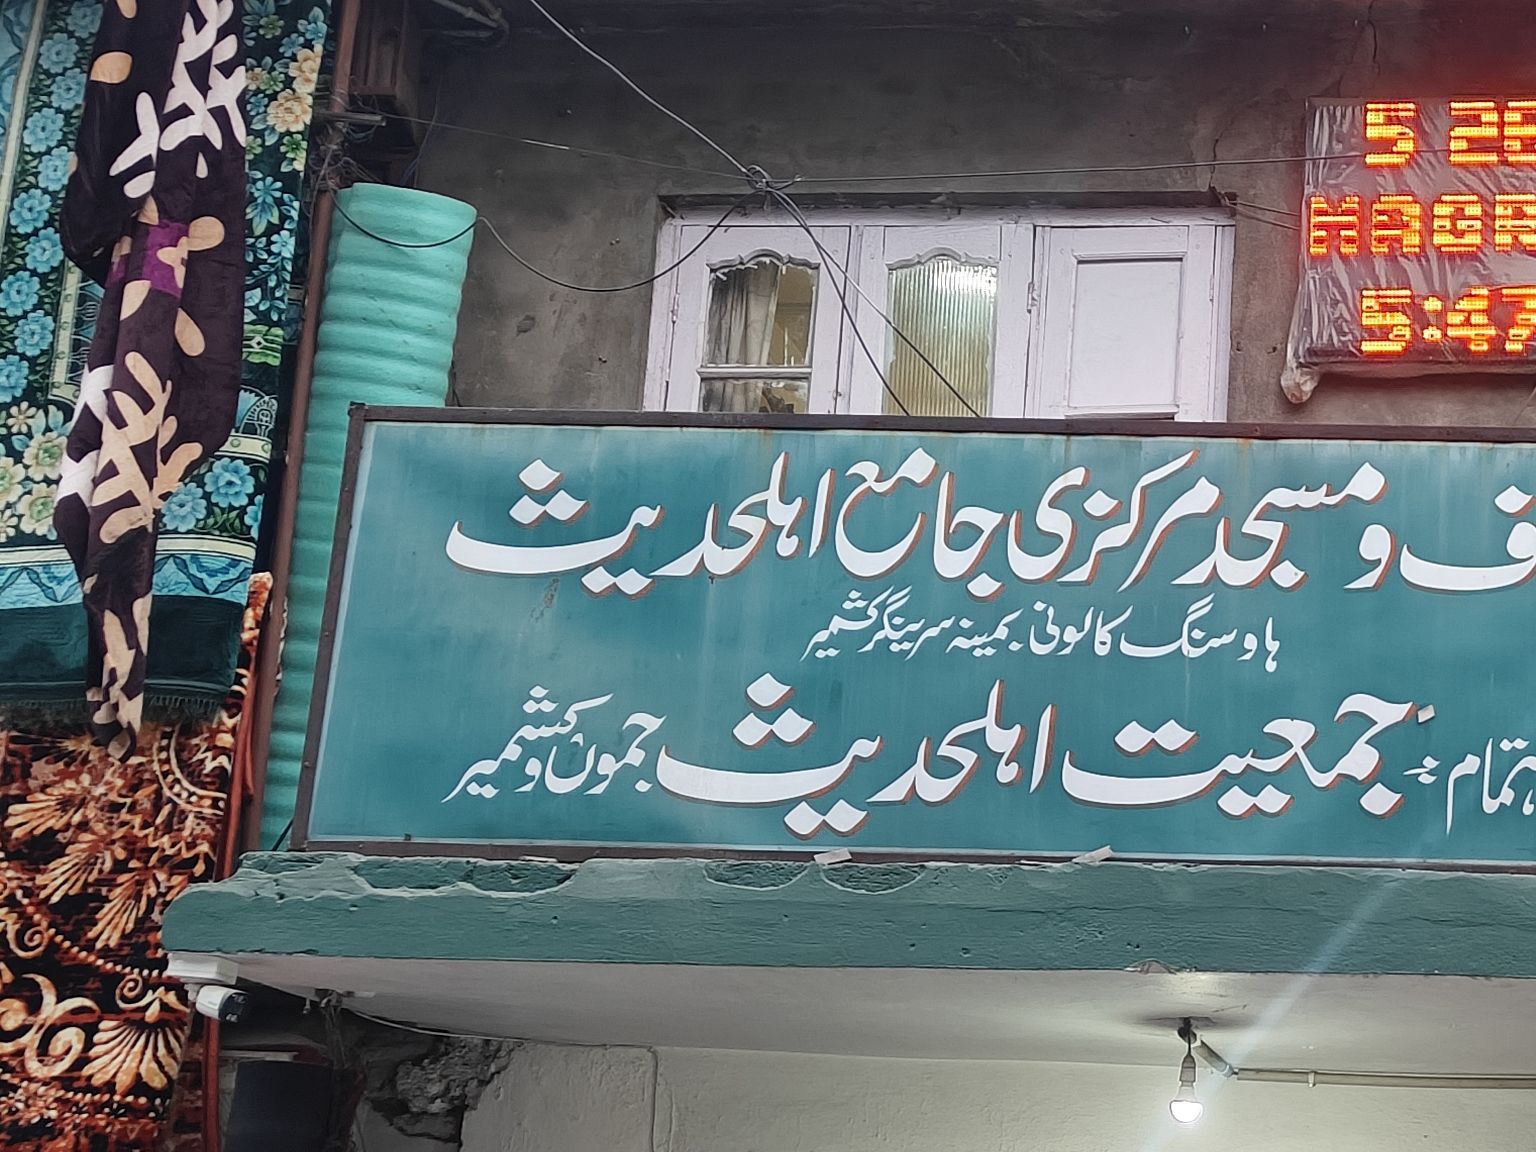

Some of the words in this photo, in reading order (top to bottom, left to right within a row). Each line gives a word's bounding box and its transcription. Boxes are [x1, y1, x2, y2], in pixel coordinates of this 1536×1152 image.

[1364, 102, 1415, 167] 5
[834, 447, 1004, 600] جامع
[1006, 448, 1222, 594] مرکزی
[1171, 462, 1389, 592] مسجد
[1028, 598, 1133, 657] کالونی
[441, 685, 614, 803] کشمیر
[1061, 692, 1419, 820] جمعیت
